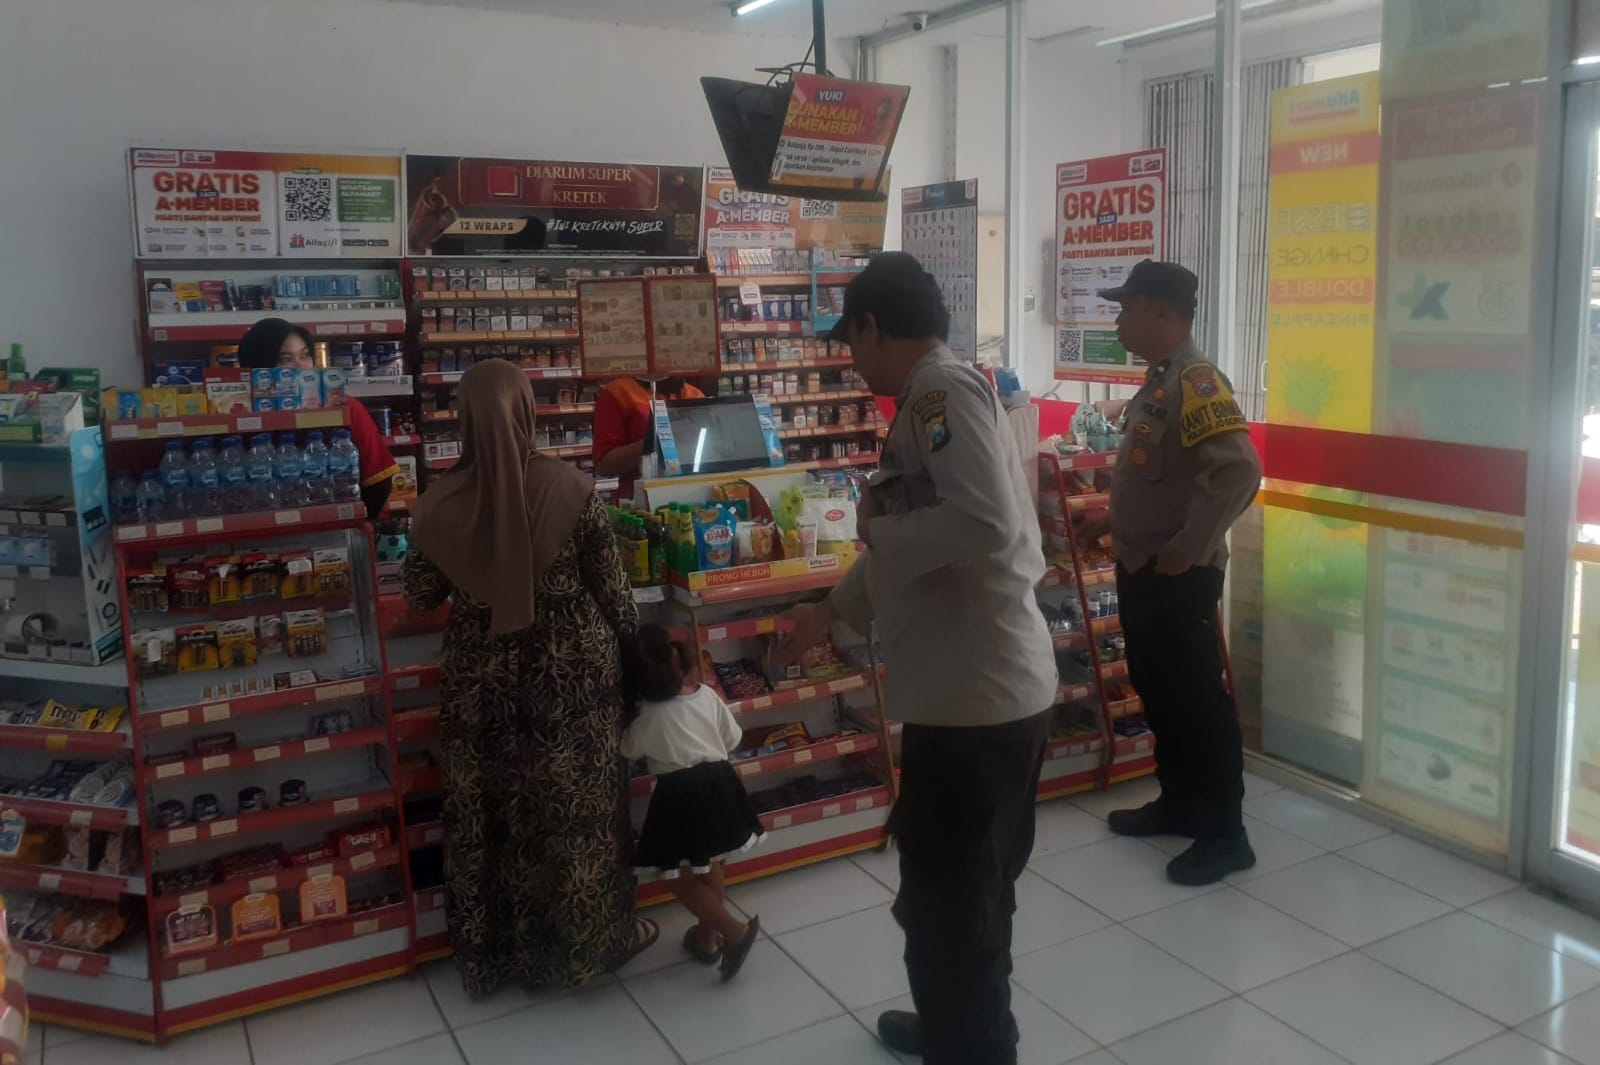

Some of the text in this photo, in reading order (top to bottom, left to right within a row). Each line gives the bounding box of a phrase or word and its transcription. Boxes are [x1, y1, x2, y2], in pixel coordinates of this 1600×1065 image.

[788, 102, 858, 122] GUNAKAN
[526, 165, 632, 182] DJARUM SUPER
[153, 171, 260, 194] GRATIS
[552, 189, 607, 204] KRETEK
[1063, 184, 1155, 221] GRATIS
[459, 220, 514, 231] 12 WRAPS
[706, 571, 739, 583] PROMO
